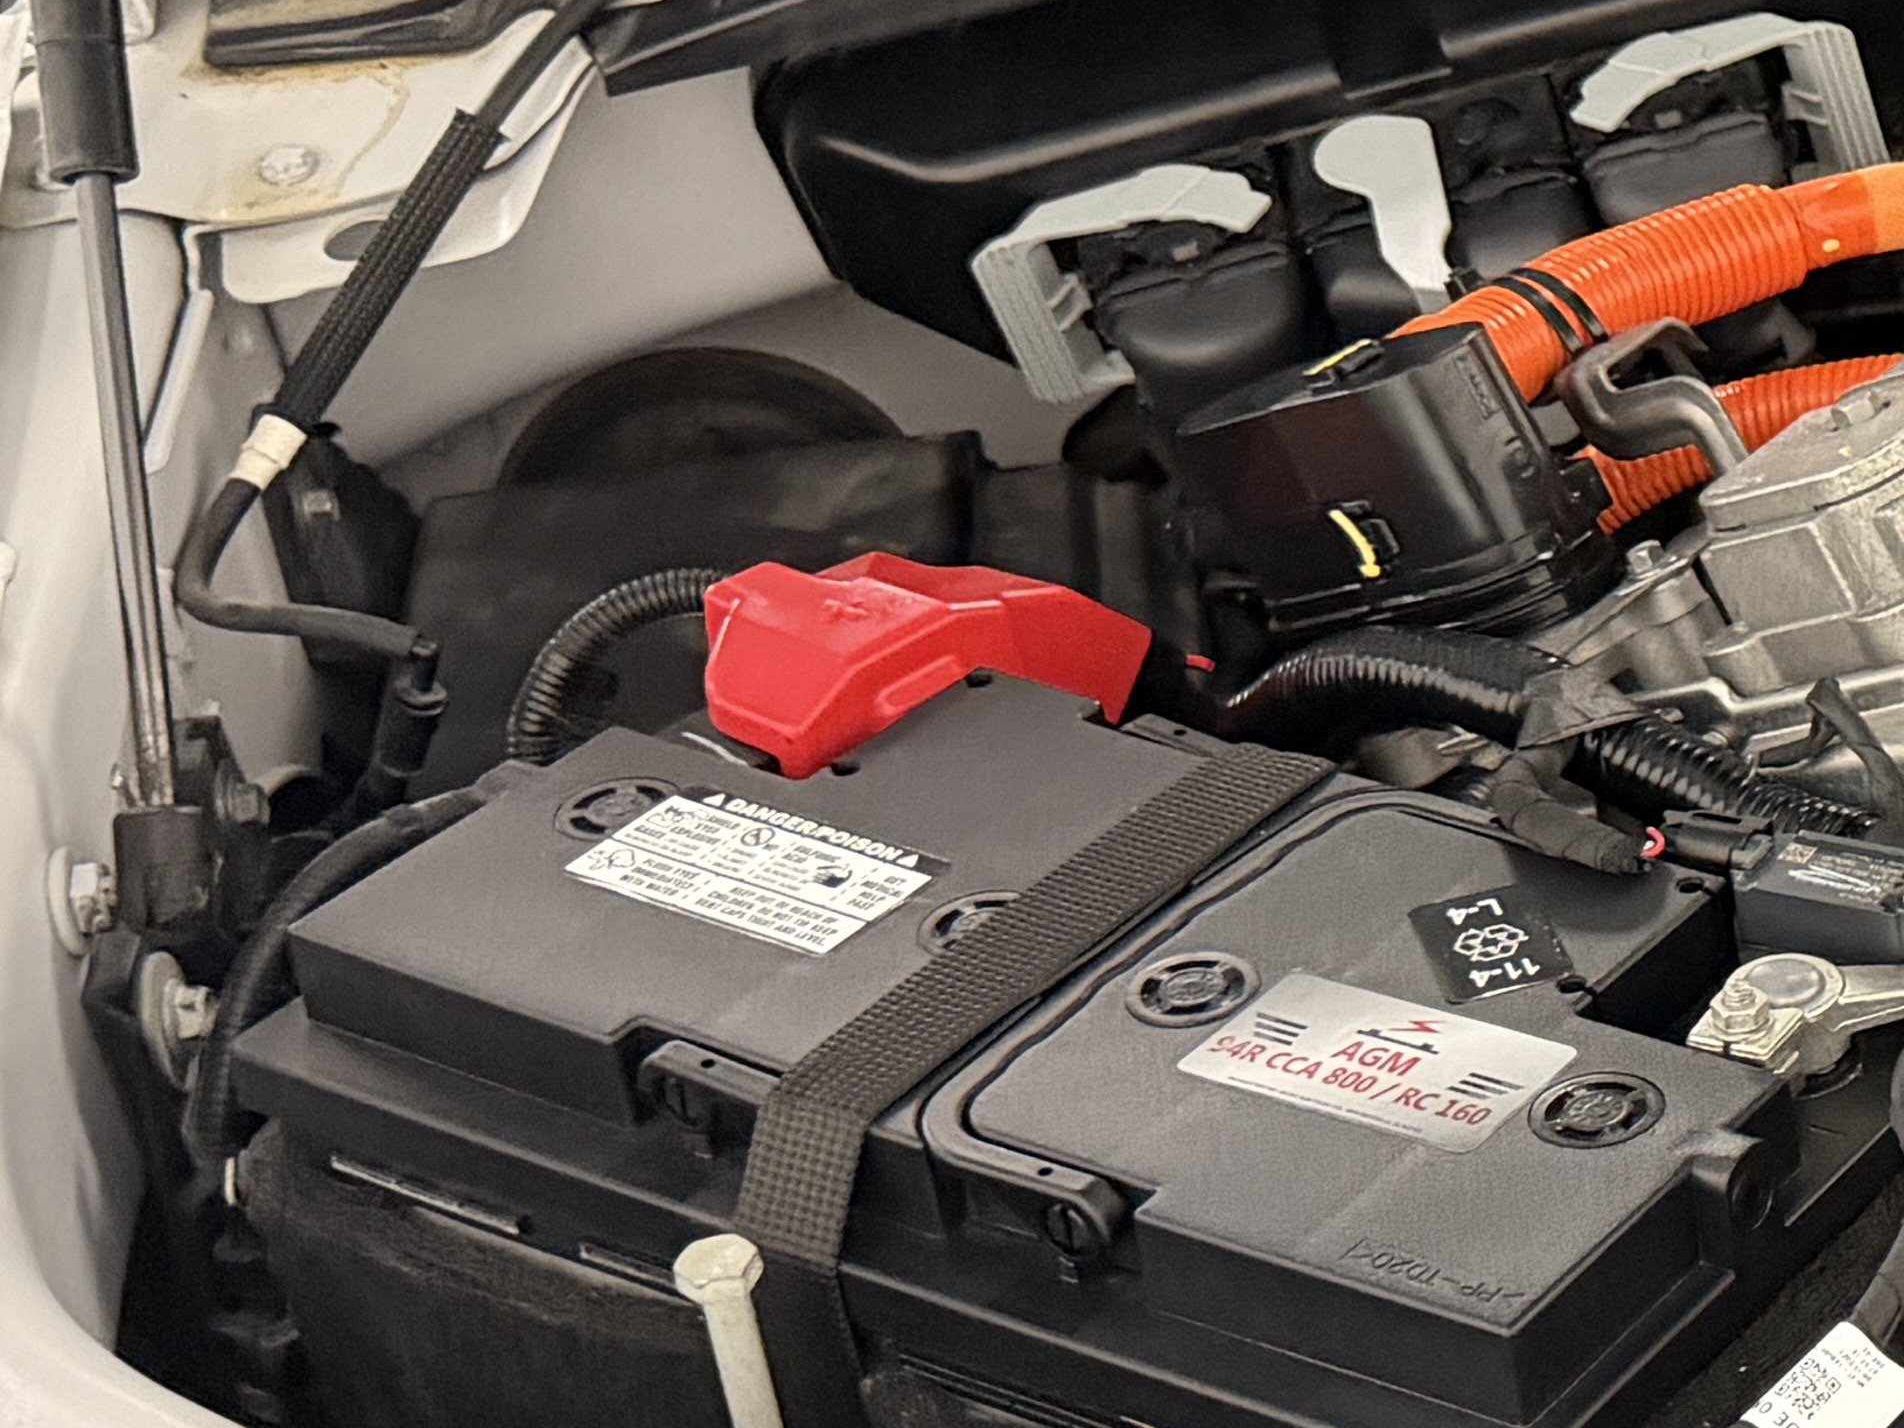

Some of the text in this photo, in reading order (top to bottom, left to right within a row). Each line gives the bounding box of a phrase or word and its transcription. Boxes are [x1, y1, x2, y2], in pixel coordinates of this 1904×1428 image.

[1206, 1035, 1266, 1064] 94R
[1266, 1052, 1324, 1080] CCA
[1323, 1069, 1379, 1094] 800
[1370, 1083, 1398, 1101] /
[1396, 1087, 1438, 1112] RC
[1435, 1101, 1493, 1126] 160
[1330, 1040, 1423, 1077] AGM
